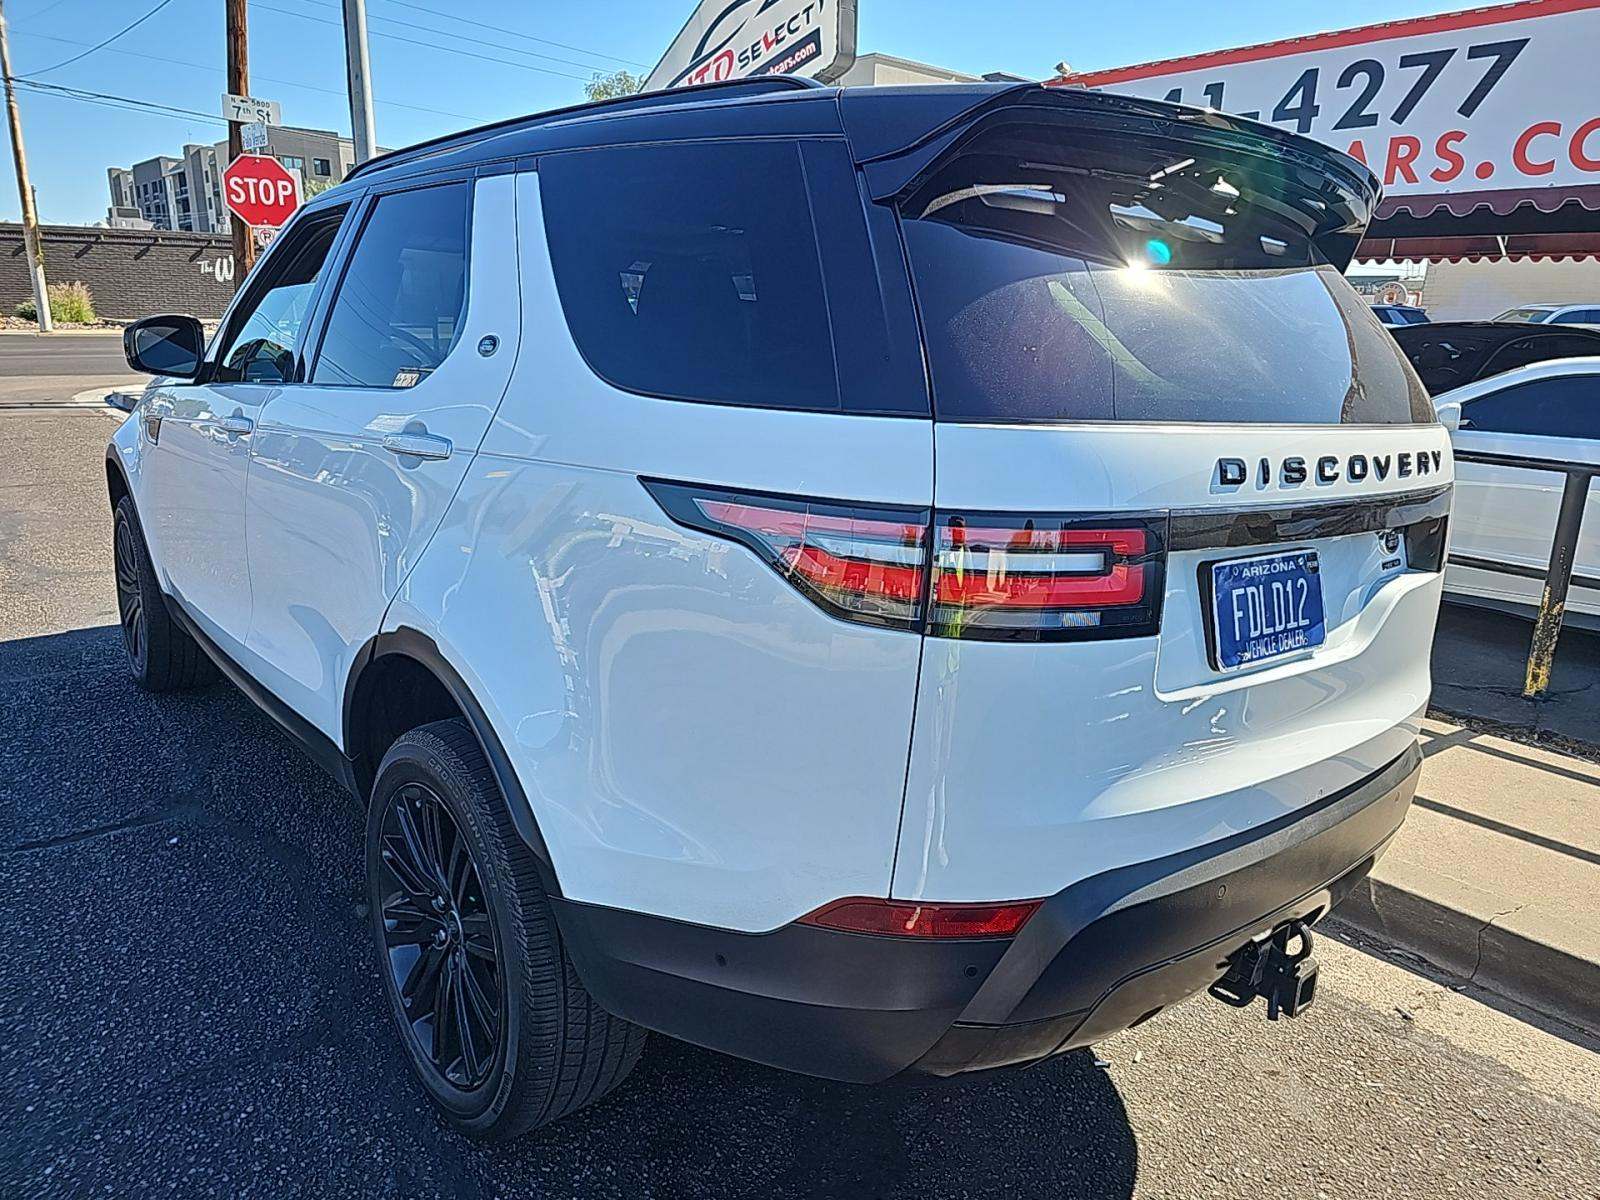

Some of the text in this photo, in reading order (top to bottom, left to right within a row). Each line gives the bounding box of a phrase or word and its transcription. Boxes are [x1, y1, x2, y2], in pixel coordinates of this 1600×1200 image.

[687, 4, 815, 85] TO SELECT
[766, 42, 817, 76] tcars.com
[232, 105, 271, 124] 7th St
[251, 99, 271, 108] 5800
[229, 176, 293, 206] STOP
[197, 260, 215, 274] The
[1218, 450, 1442, 487] DISCOVERY
[1241, 560, 1297, 579] ARIZONA
[1231, 577, 1311, 642] FDLD12
[1245, 629, 1305, 660] VEHICLE DEALER
